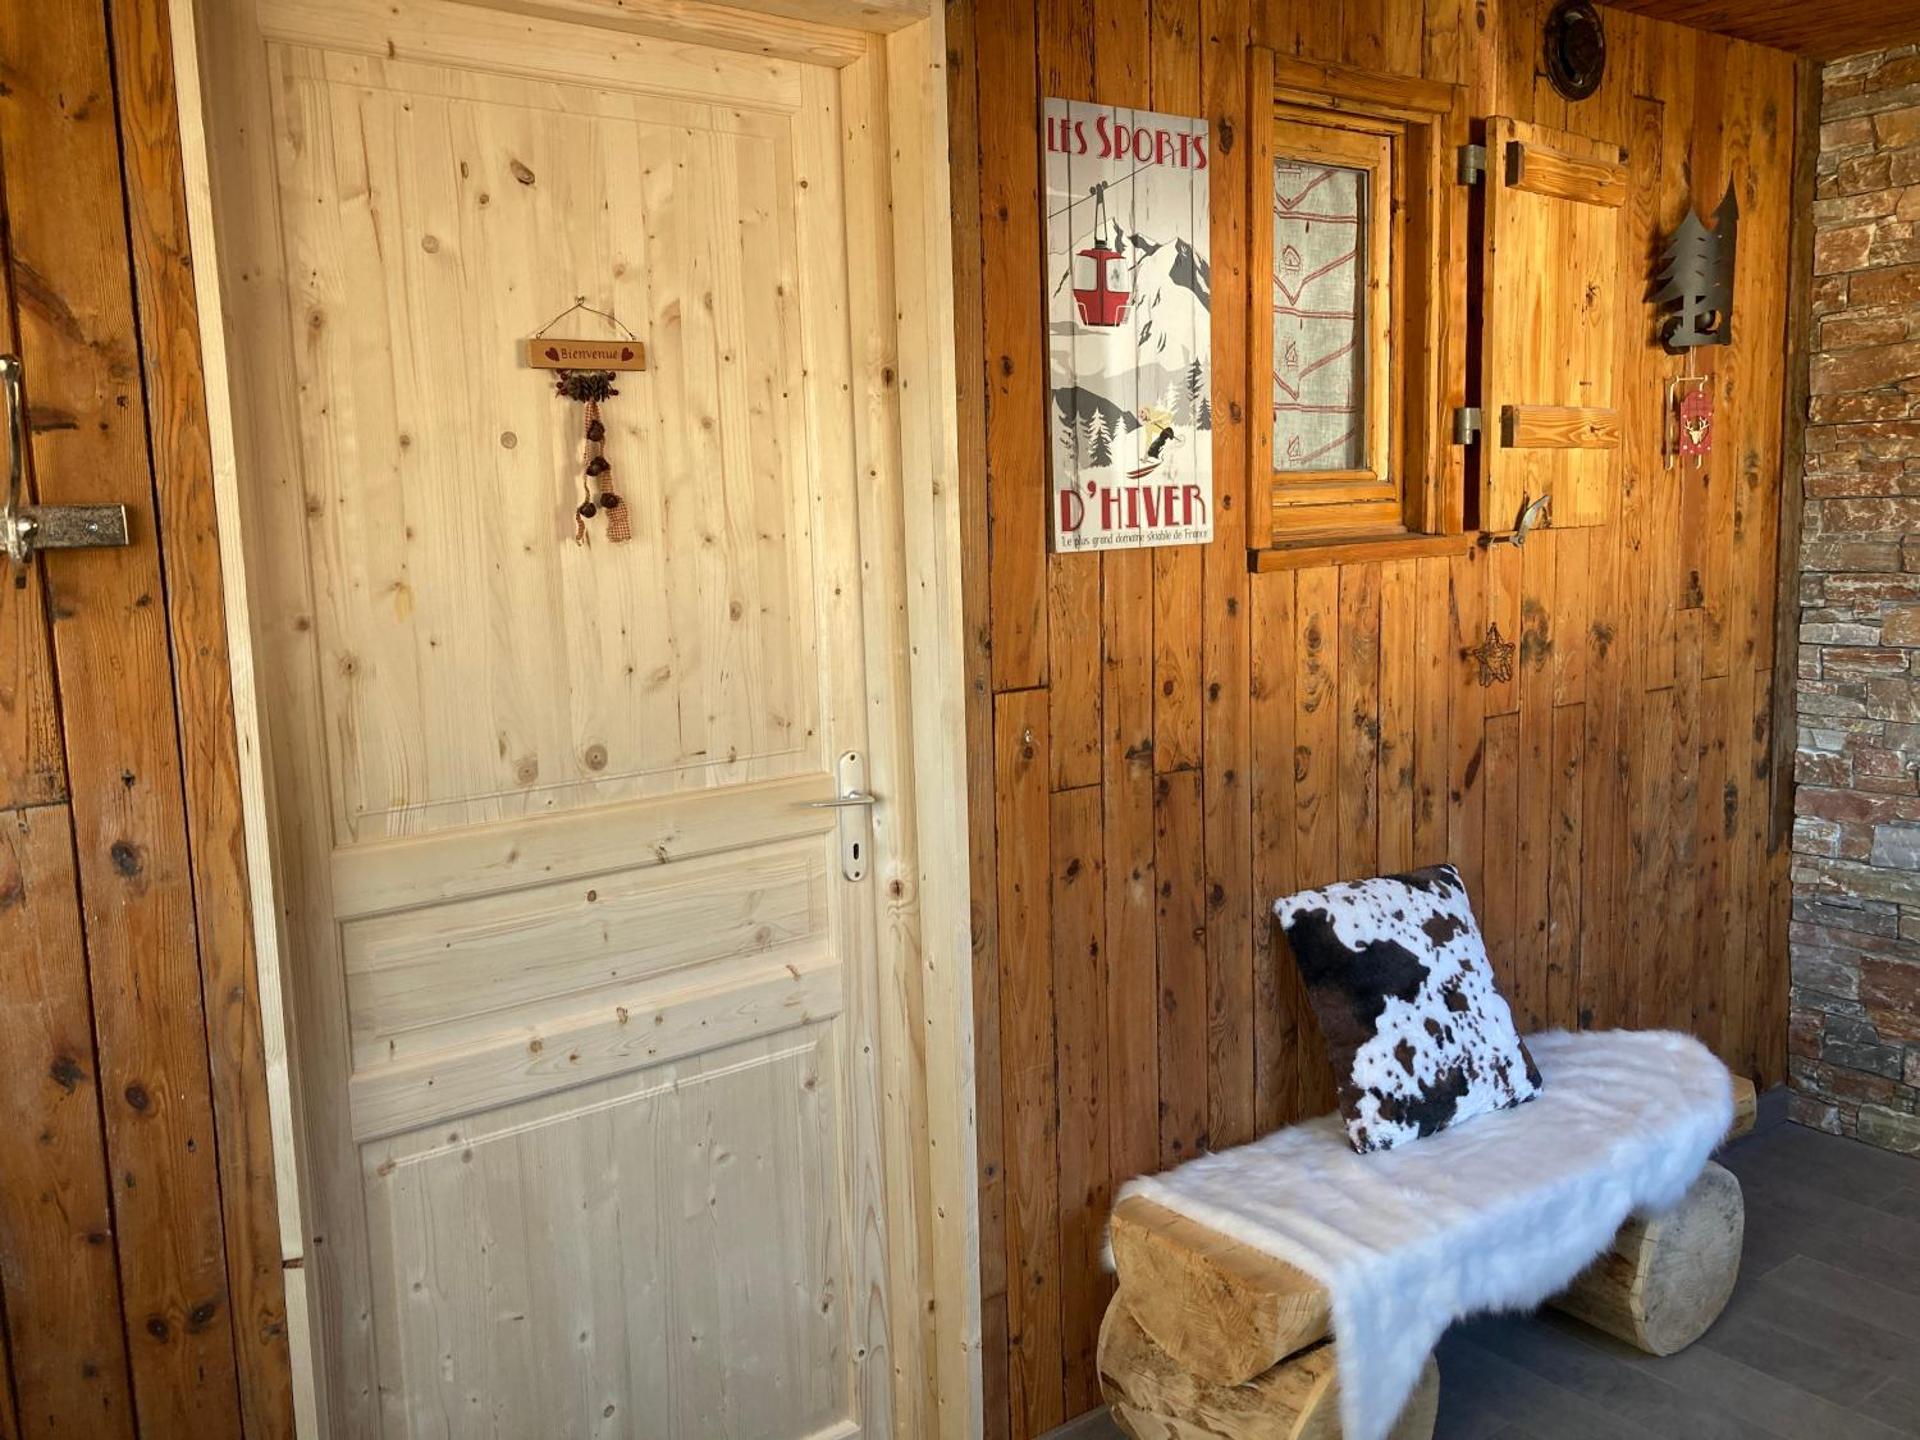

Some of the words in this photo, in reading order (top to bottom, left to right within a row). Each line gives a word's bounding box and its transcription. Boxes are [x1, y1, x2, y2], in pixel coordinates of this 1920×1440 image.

[1047, 116, 1088, 155] LES
[1096, 115, 1208, 170] SPORTS
[561, 348, 618, 360] Bienvenue
[1060, 480, 1206, 532] D'HIVER
[1061, 535, 1072, 547] Le
[1073, 533, 1090, 549] plus
[1092, 533, 1113, 548] grand
[1115, 531, 1145, 545] domaine
[1147, 529, 1172, 541] skiable
[1173, 529, 1182, 540] de
[1185, 528, 1208, 540] France
